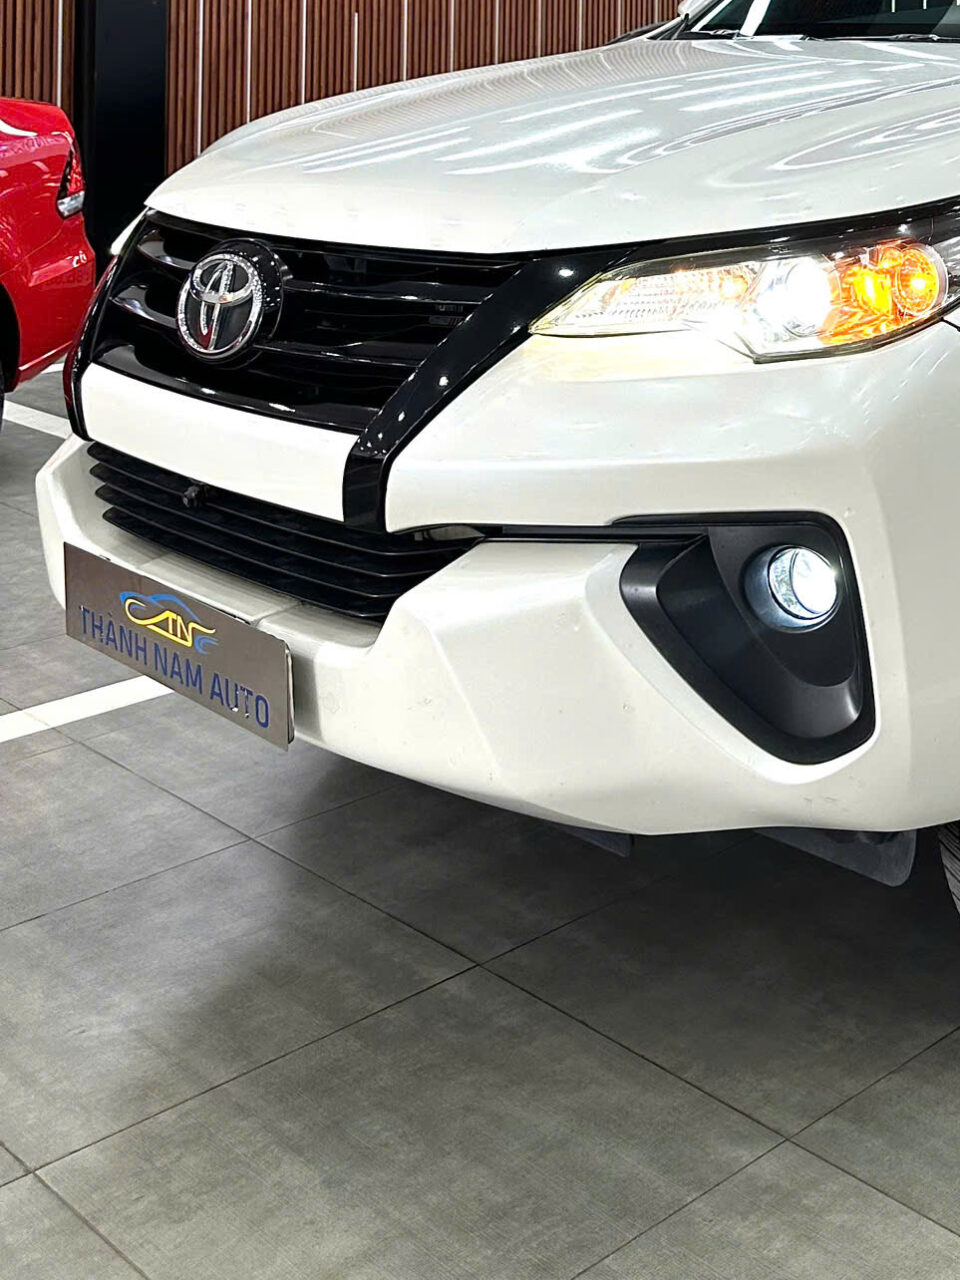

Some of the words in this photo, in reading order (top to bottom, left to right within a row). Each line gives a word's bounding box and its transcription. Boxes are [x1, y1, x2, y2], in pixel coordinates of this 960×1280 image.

[79, 605, 148, 666] THÀNH
[153, 642, 203, 695] NAM
[209, 672, 270, 729] AUTO
